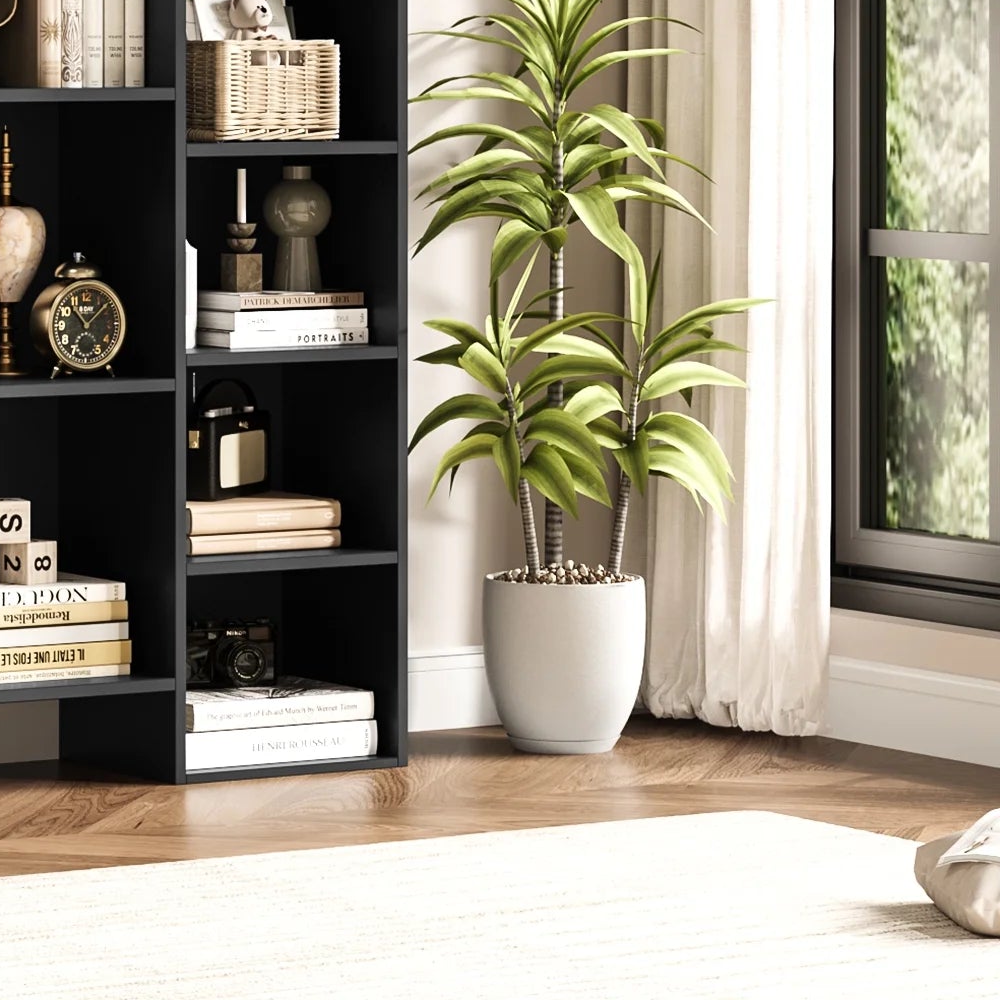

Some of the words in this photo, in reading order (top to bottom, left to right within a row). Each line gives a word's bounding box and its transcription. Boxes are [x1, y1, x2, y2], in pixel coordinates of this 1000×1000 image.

[71, 296, 78, 306] 11
[82, 292, 91, 302] 12
[244, 296, 279, 306] PATRICK
[61, 306, 71, 317] 10
[58, 320, 66, 331] 9
[61, 334, 69, 345] 8
[103, 334, 110, 343] 4
[297, 332, 354, 343] PORTRAITS
[70, 345, 77, 355] 7
[94, 344, 101, 354] 5
[0, 513, 23, 533] S
[4, 554, 21, 571] 2
[34, 555, 51, 571] 8
[3, 610, 70, 624] Remodelista
[1, 653, 11, 666] LE
[13, 651, 31, 665] FOIS
[34, 650, 51, 663] UNE
[52, 649, 75, 664] ÉTAIT
[79, 648, 85, 661] IL
